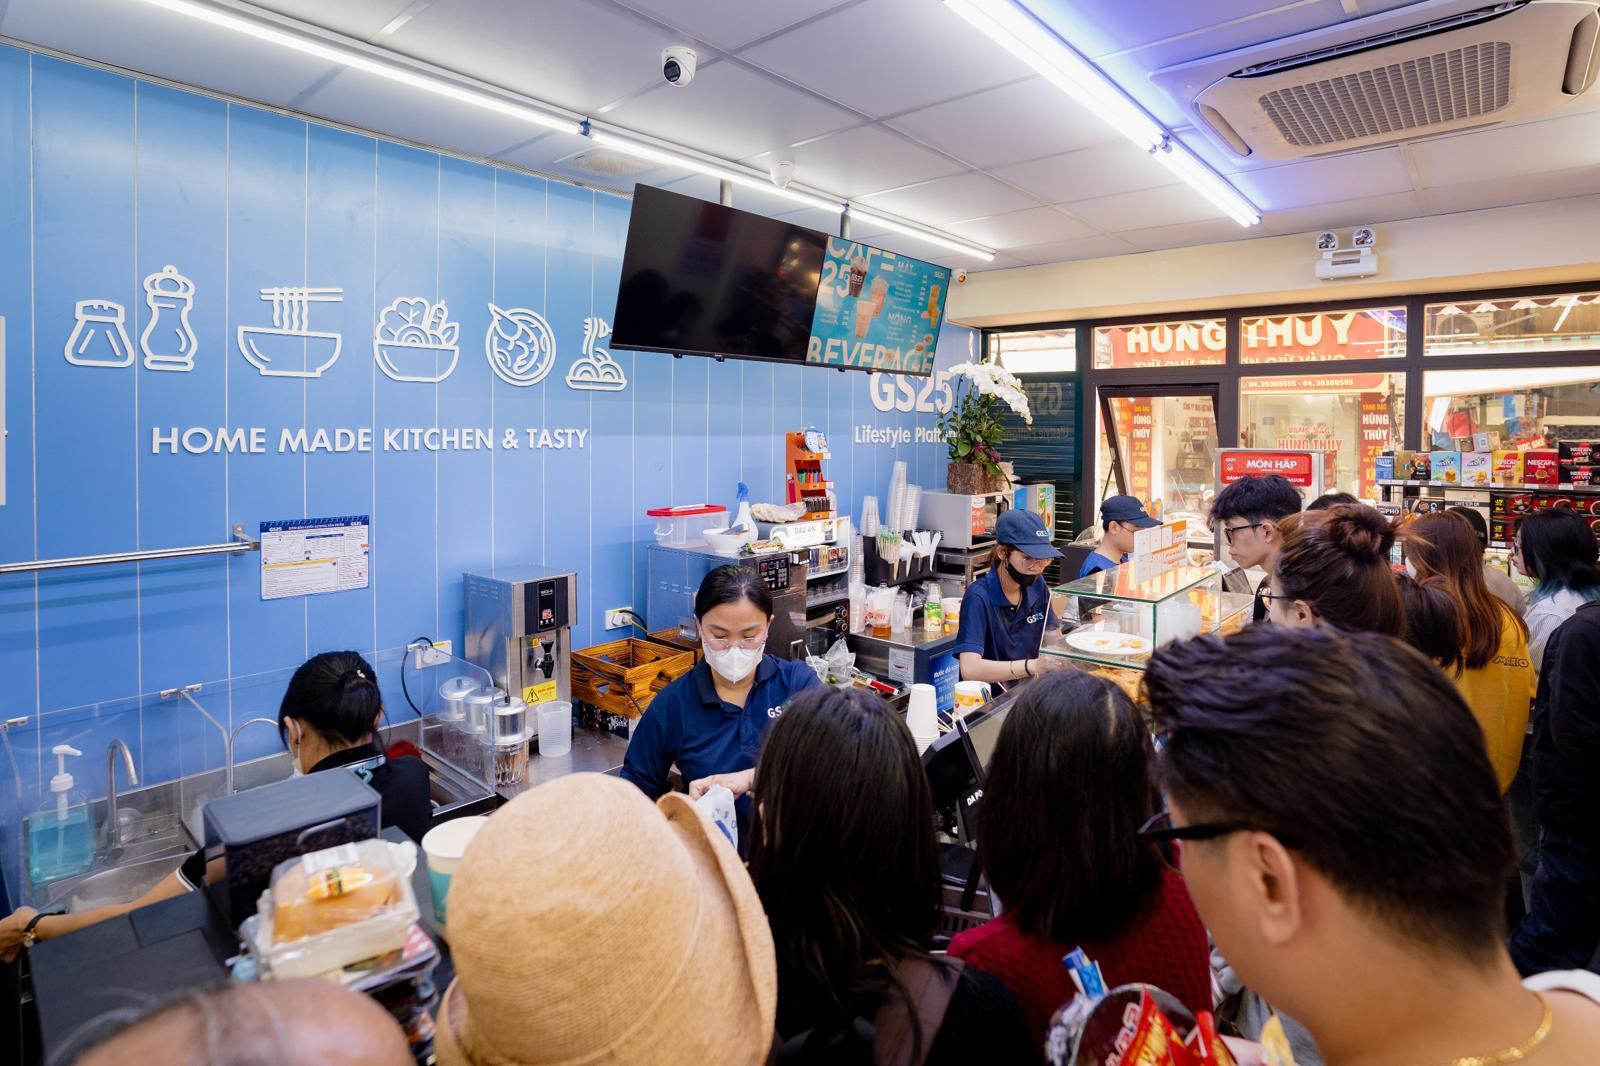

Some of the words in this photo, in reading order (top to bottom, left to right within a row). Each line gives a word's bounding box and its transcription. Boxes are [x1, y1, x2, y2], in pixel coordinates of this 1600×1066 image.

[870, 371, 953, 414] GS25
[152, 427, 266, 454] HOME
[278, 428, 372, 453] MADE
[383, 428, 494, 451] KITCHEN
[501, 429, 519, 451] &
[526, 428, 589, 450] TASTY
[855, 425, 911, 448] Lifestyle
[1247, 457, 1273, 468] MÓN
[1026, 612, 1044, 624] GS25
[1491, 655, 1529, 668] MARIO
